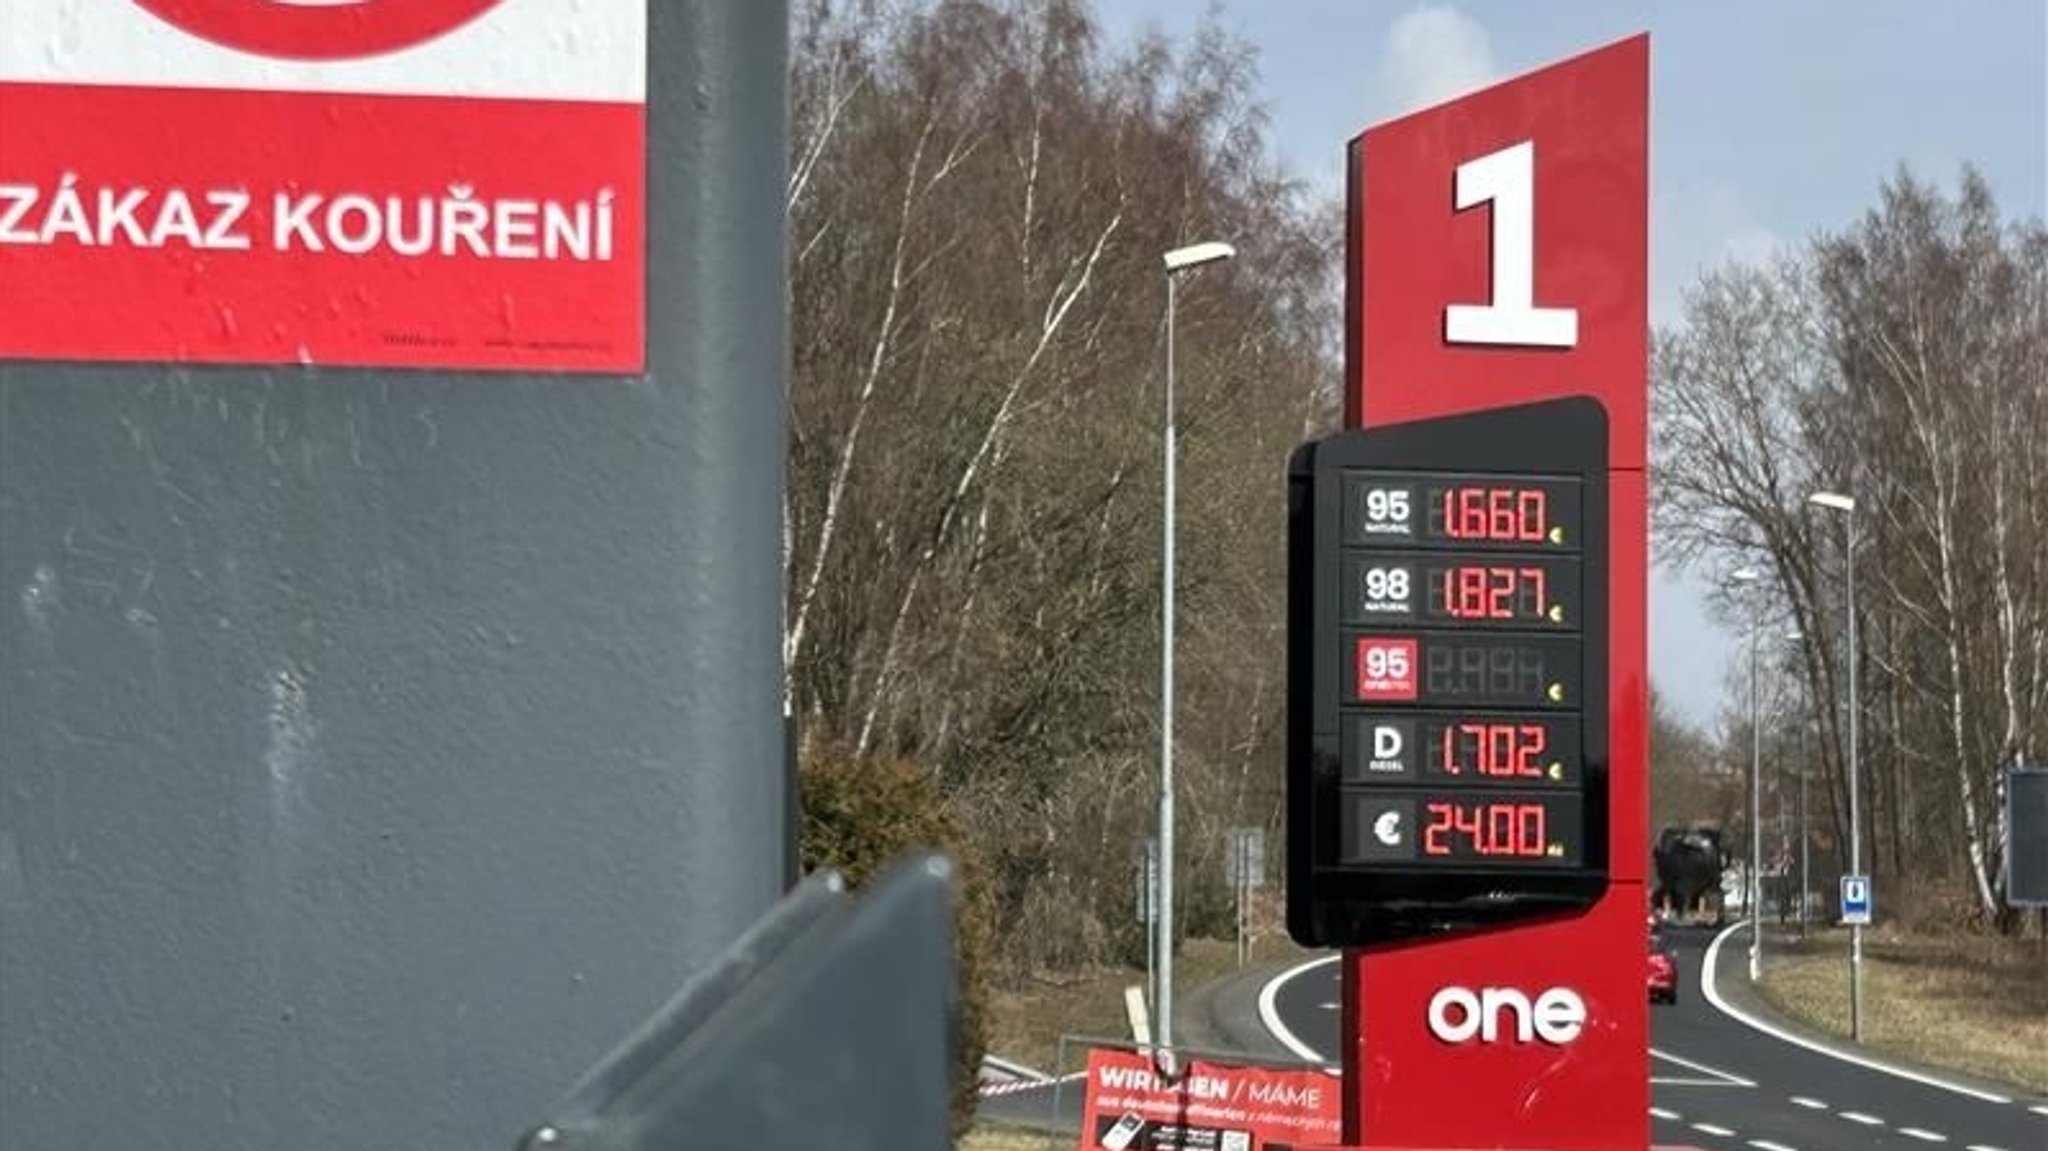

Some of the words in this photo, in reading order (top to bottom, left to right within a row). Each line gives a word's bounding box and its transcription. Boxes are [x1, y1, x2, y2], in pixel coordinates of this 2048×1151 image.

[0, 174, 249, 250] ZÁKAZ
[274, 184, 613, 260] KOUŘENÍ
[1446, 138, 1577, 346] 1
[1367, 490, 1409, 520] 95
[1366, 568, 1410, 600] 98
[1445, 568, 1544, 618] 1.827
[1366, 647, 1409, 679] 95
[1375, 726, 1402, 759] D
[1444, 724, 1545, 776] 1.702
[1374, 811, 1401, 845] €
[1425, 804, 1545, 855] 24.00
[1428, 986, 1587, 1043] one
[1099, 1066, 1153, 1092] WIR
[1248, 1080, 1321, 1108] MÁME
